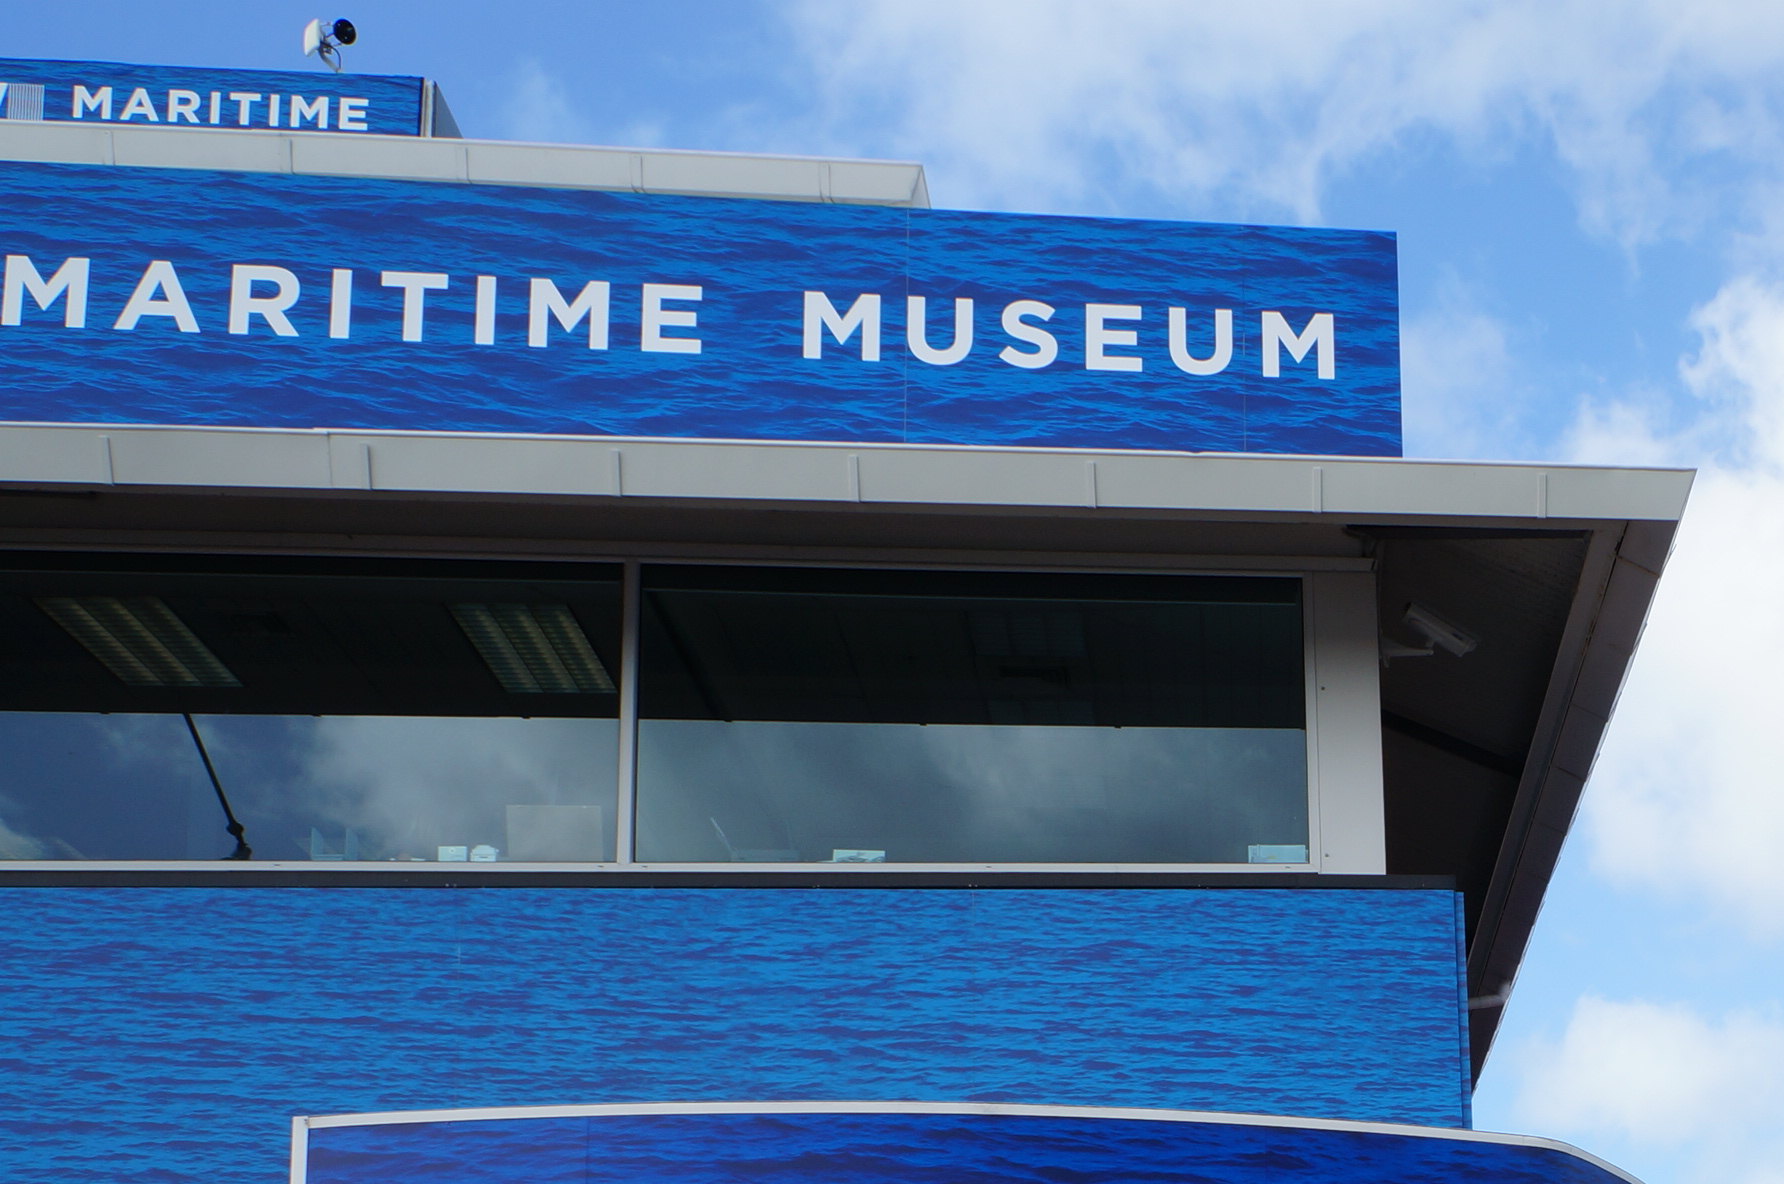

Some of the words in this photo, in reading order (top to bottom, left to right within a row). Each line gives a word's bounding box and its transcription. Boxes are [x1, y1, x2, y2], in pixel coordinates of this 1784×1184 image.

[72, 85, 370, 131] MARITIME
[1, 254, 703, 355] MARITIME
[803, 290, 1336, 380] MUSEUM
